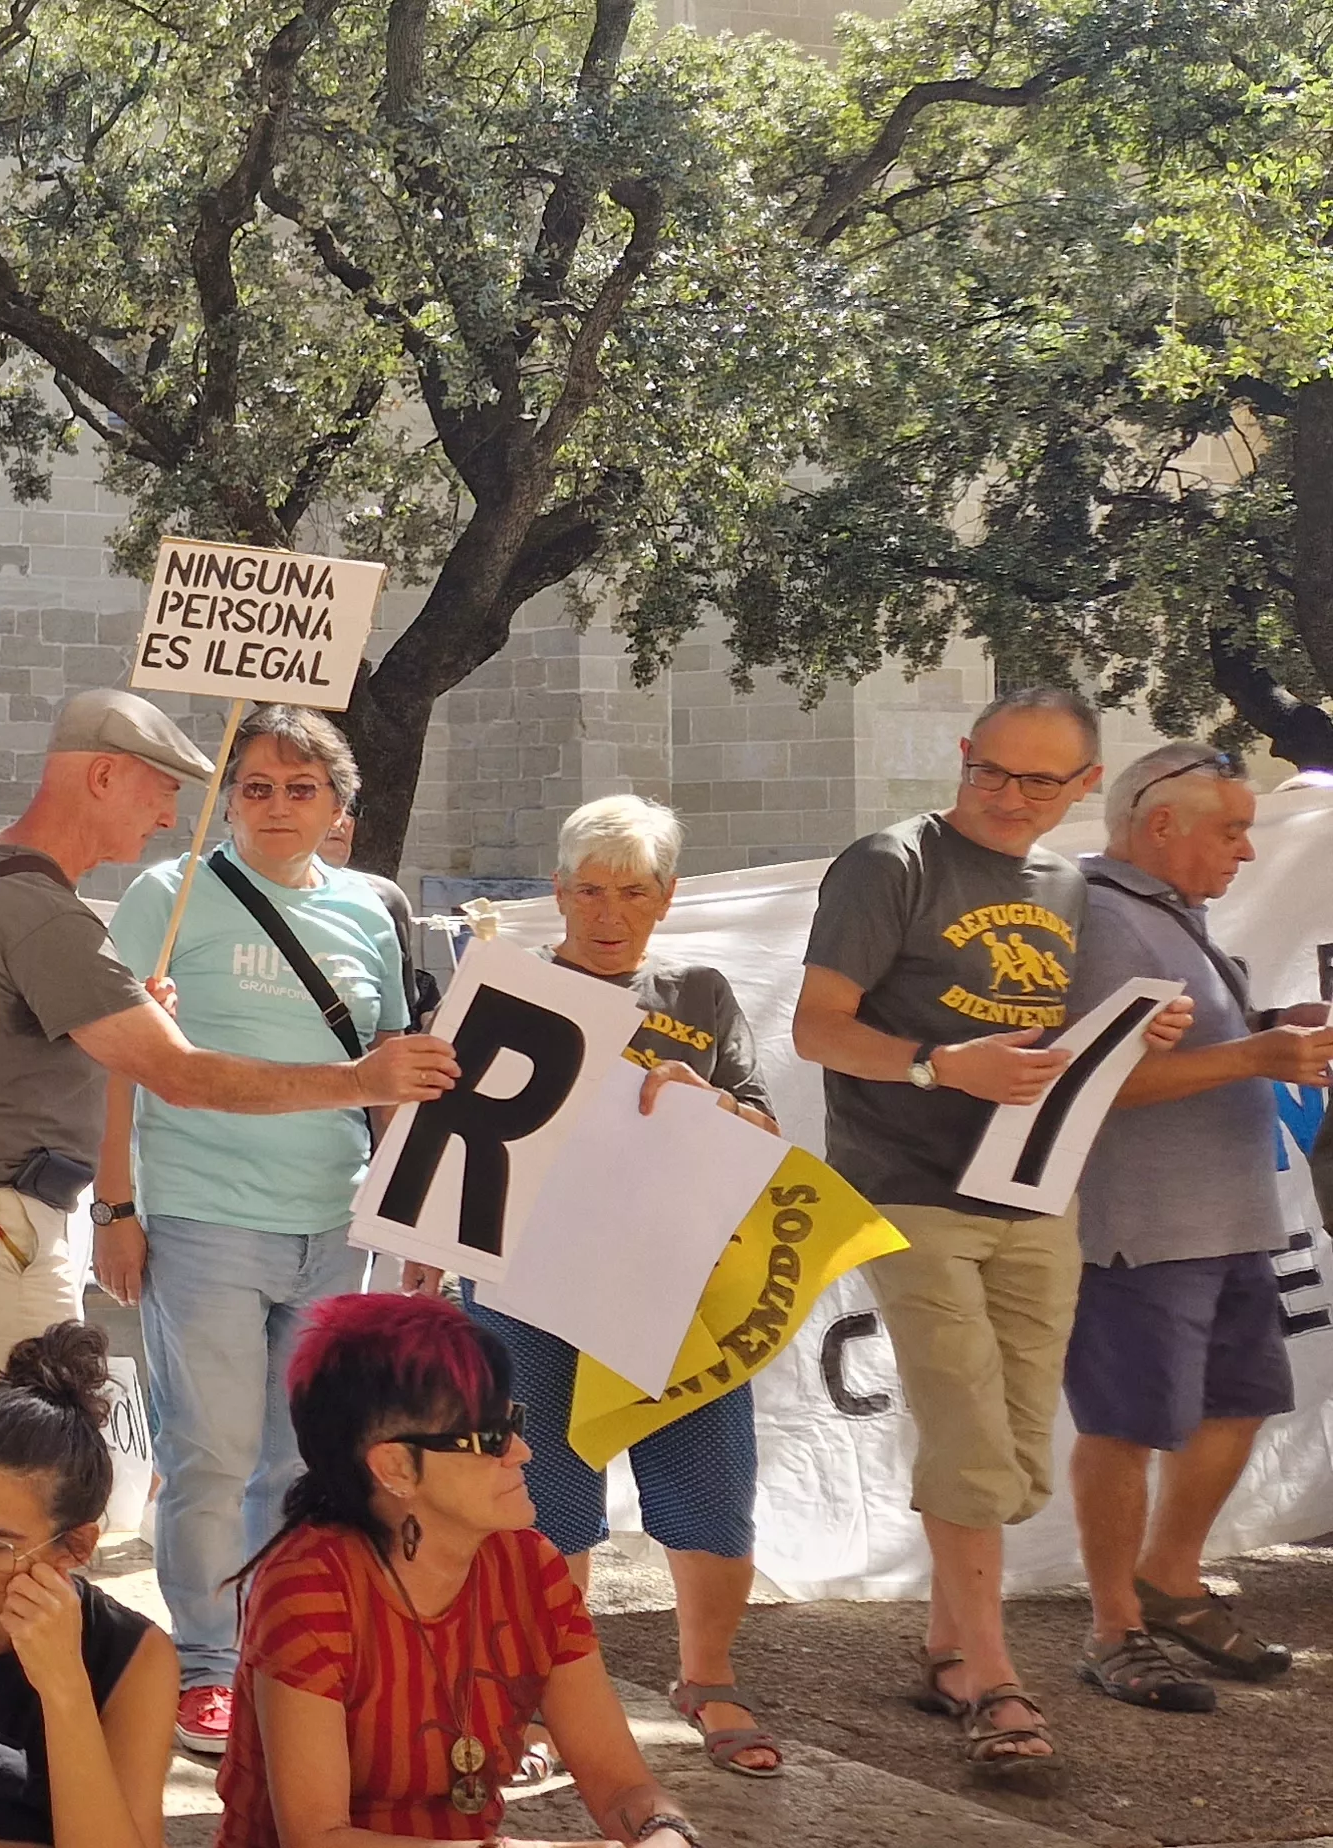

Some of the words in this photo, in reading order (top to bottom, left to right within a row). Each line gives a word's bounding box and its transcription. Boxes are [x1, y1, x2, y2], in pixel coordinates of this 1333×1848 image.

[164, 550, 335, 601] NINGUNA
[156, 589, 333, 642] PERSONA
[140, 632, 192, 671] ES
[203, 639, 331, 687] ILEGAL
